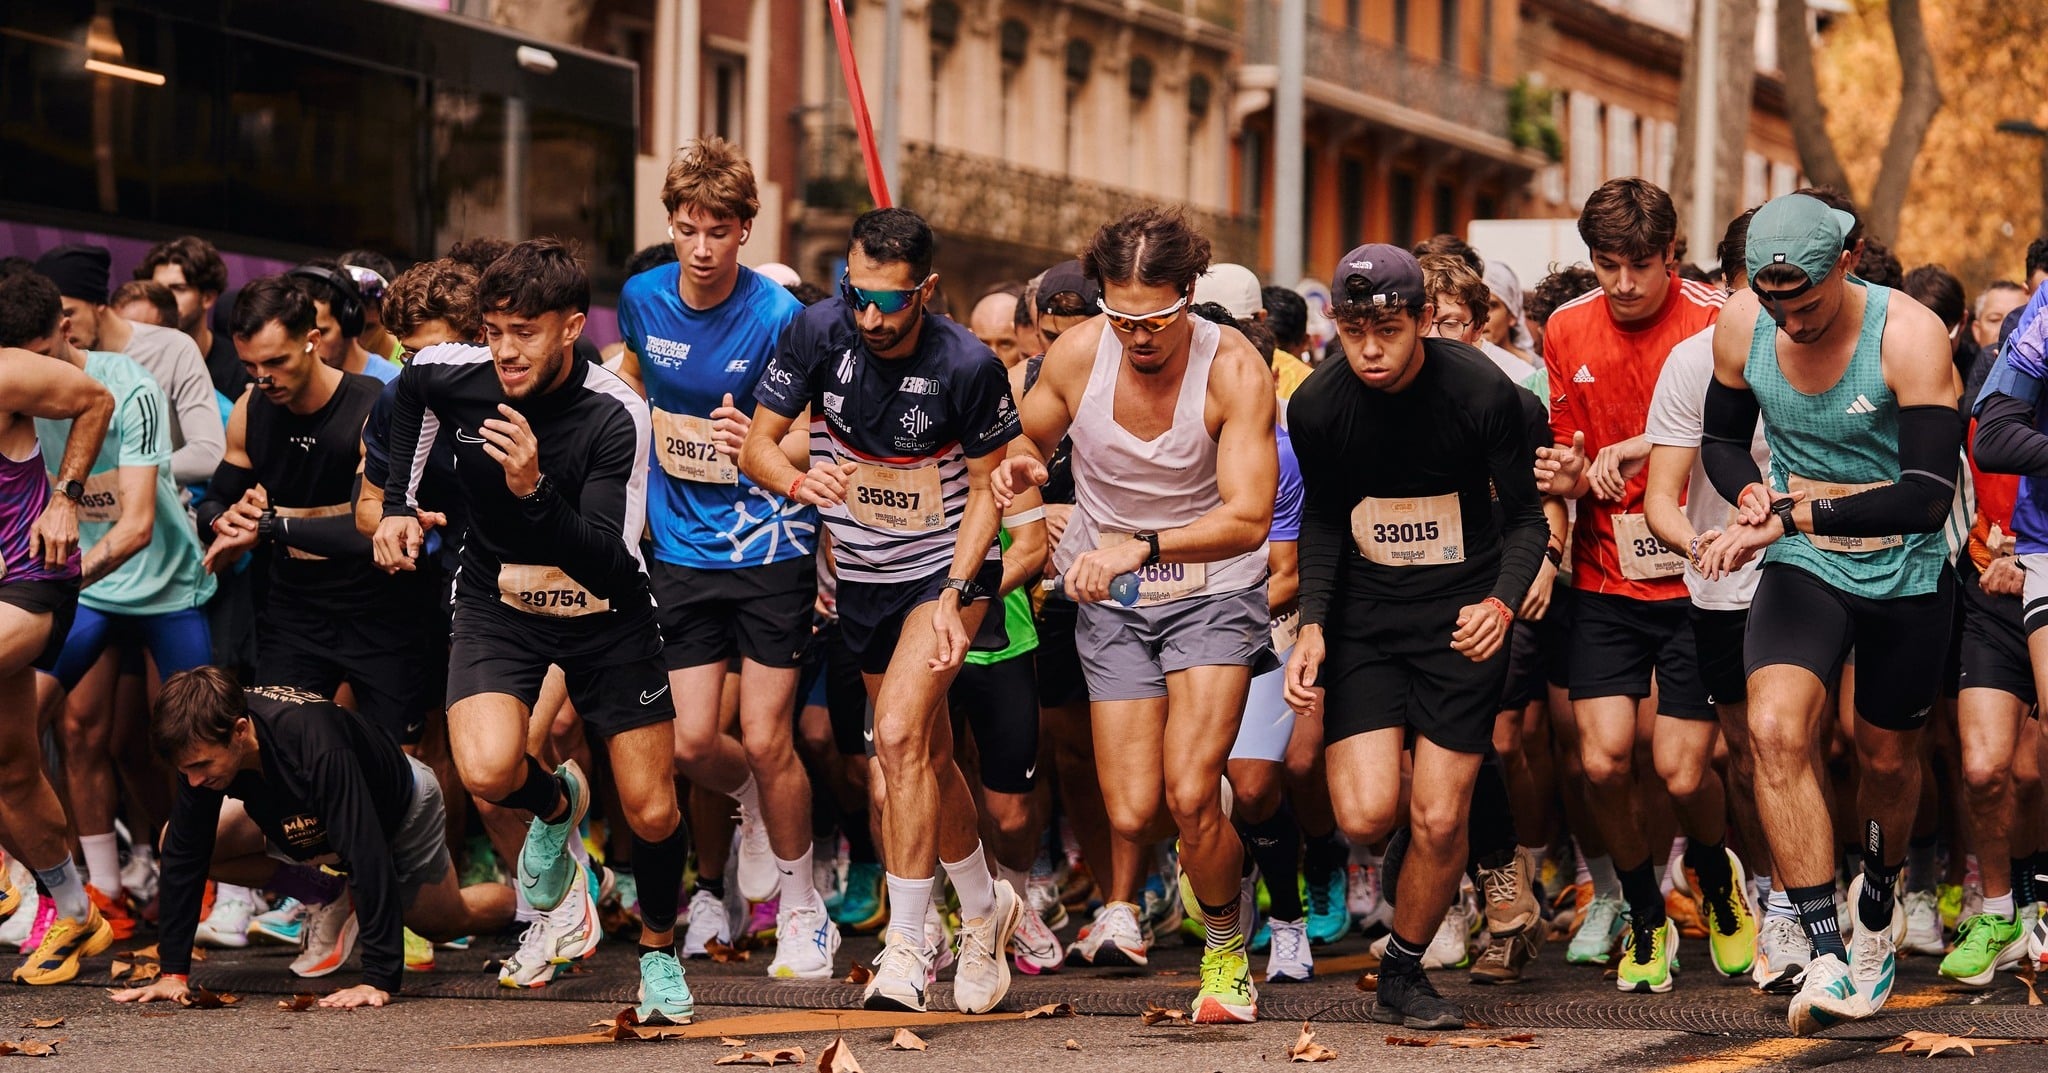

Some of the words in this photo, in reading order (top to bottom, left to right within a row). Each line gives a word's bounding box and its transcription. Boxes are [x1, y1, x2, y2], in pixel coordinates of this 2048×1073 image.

[646, 335, 691, 352] TRIATHLON
[666, 435, 718, 462] 29872
[857, 486, 920, 510] 35837
[1373, 521, 1439, 543] 33015
[520, 590, 588, 608] 29754
